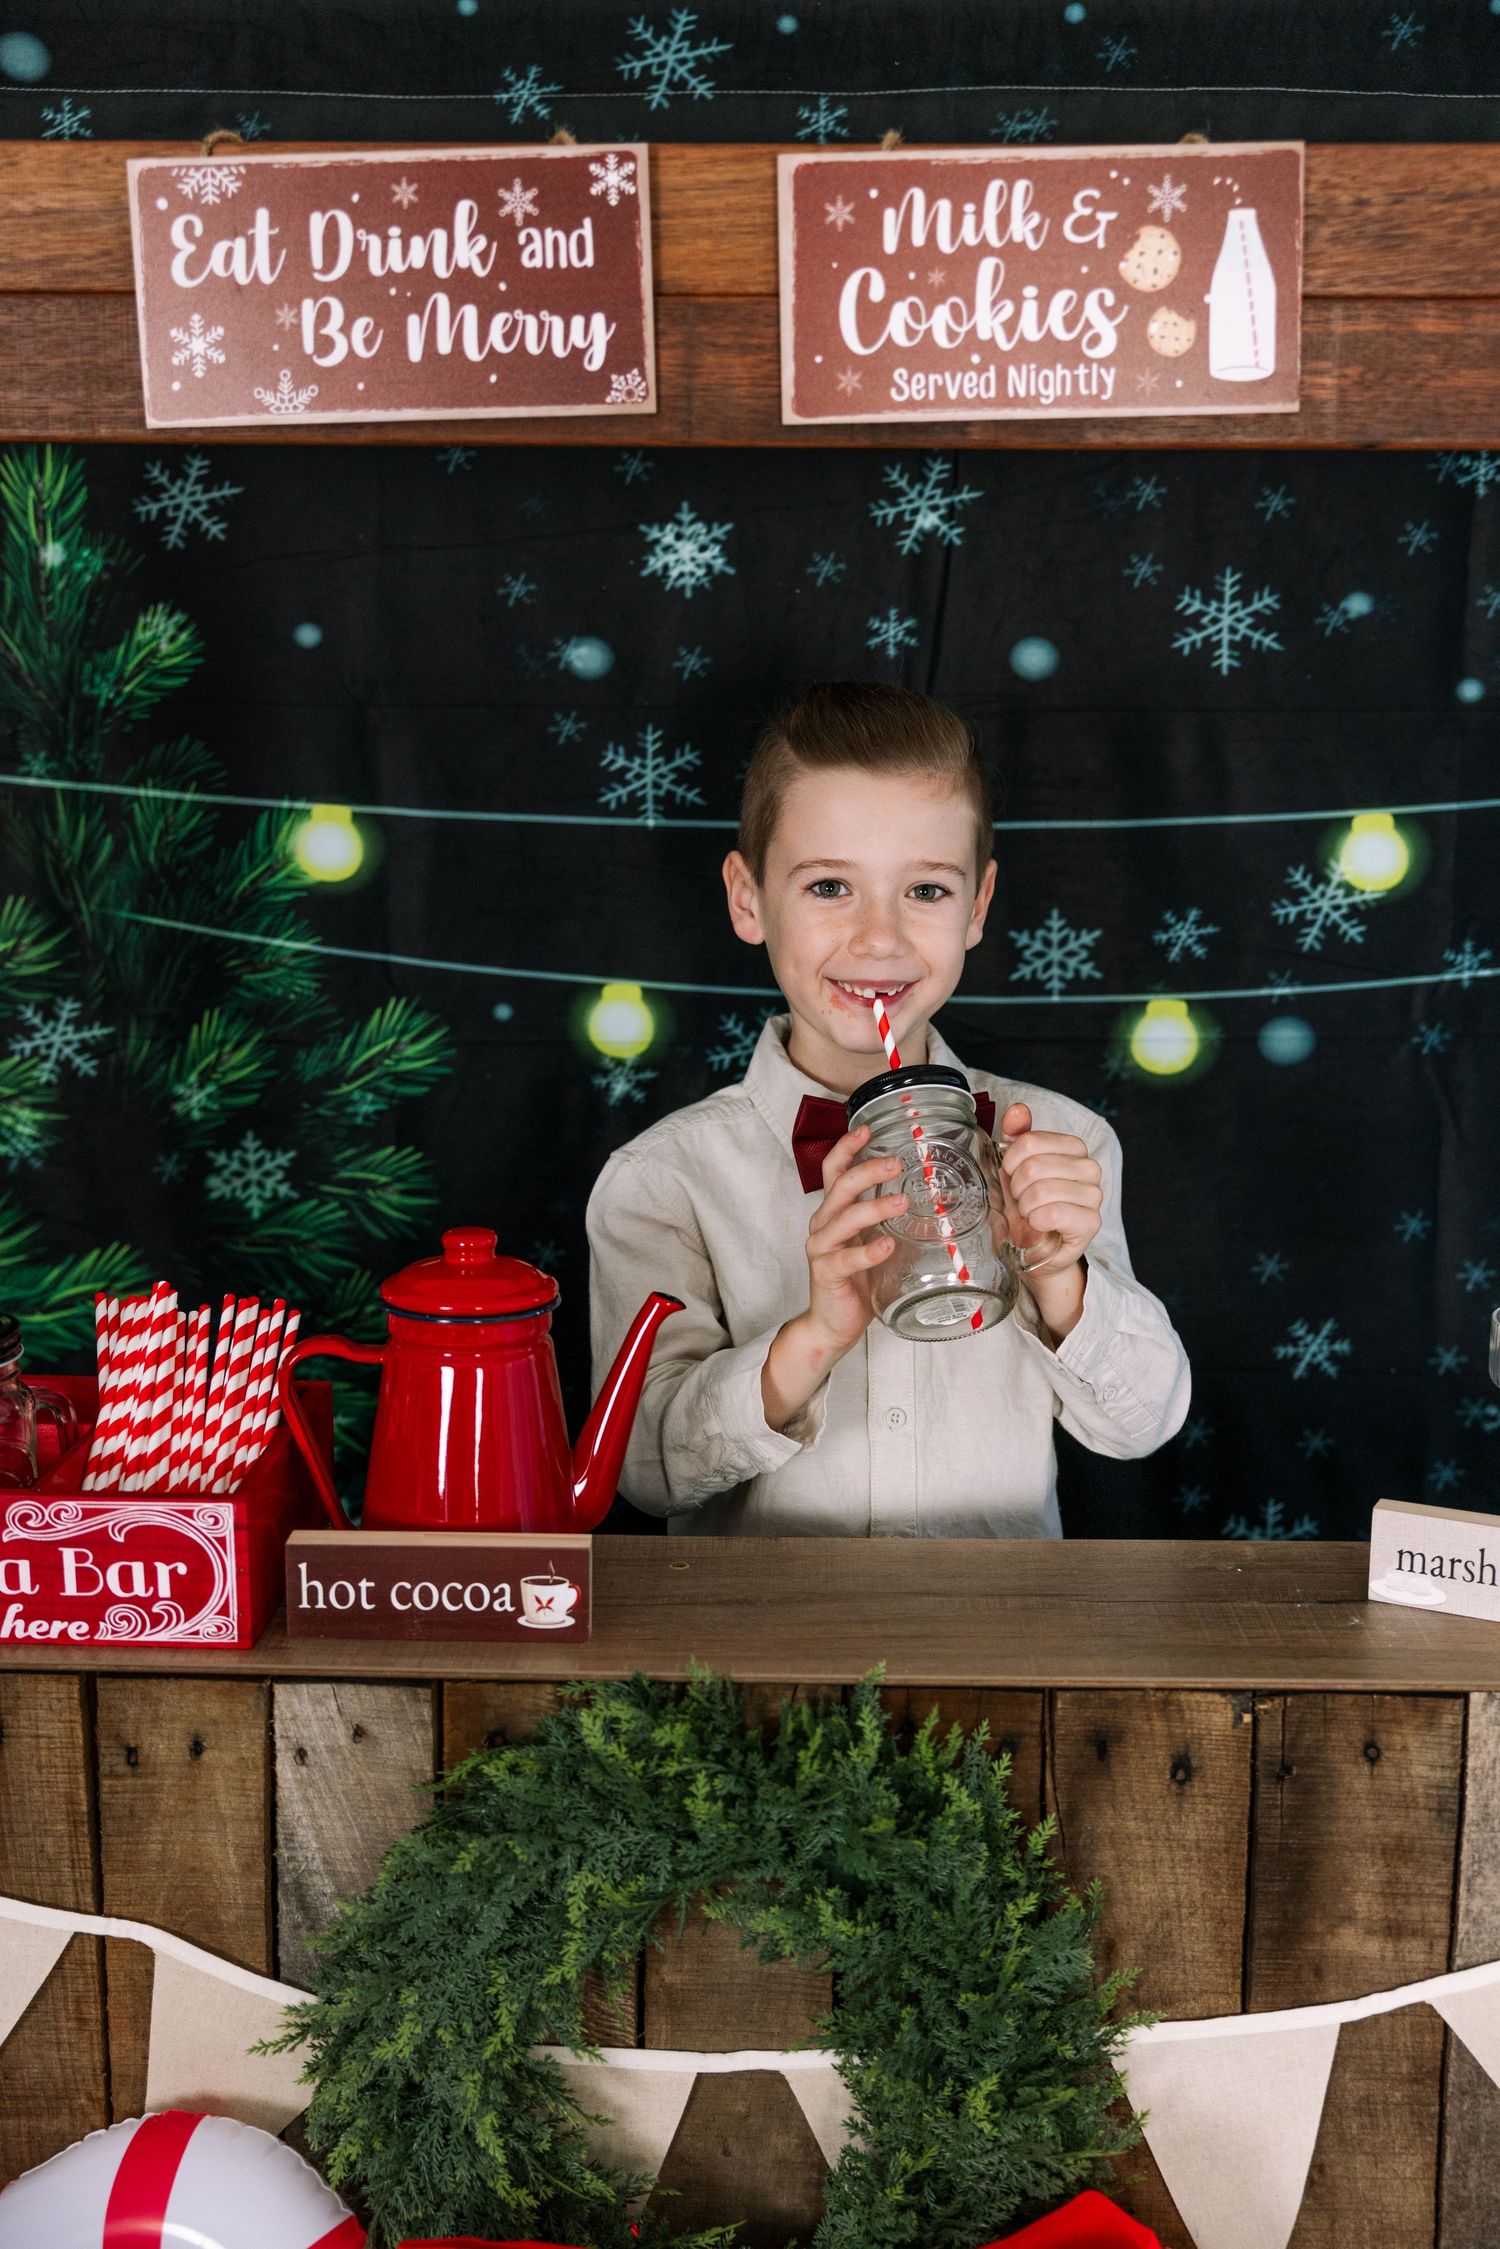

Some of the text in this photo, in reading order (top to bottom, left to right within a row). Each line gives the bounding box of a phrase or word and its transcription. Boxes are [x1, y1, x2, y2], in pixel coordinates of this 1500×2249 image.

[882, 179, 1118, 254] Milk &
[169, 199, 594, 288] Eat Drink and
[301, 292, 616, 372] Be Merry
[838, 256, 1128, 359] Cookies
[890, 366, 1116, 404] Served Nightly
[58, 1547, 188, 1598] Bar
[298, 1562, 516, 1612] hot cocoa
[1395, 1547, 1498, 1587] marsh
[0, 1603, 91, 1640] here
